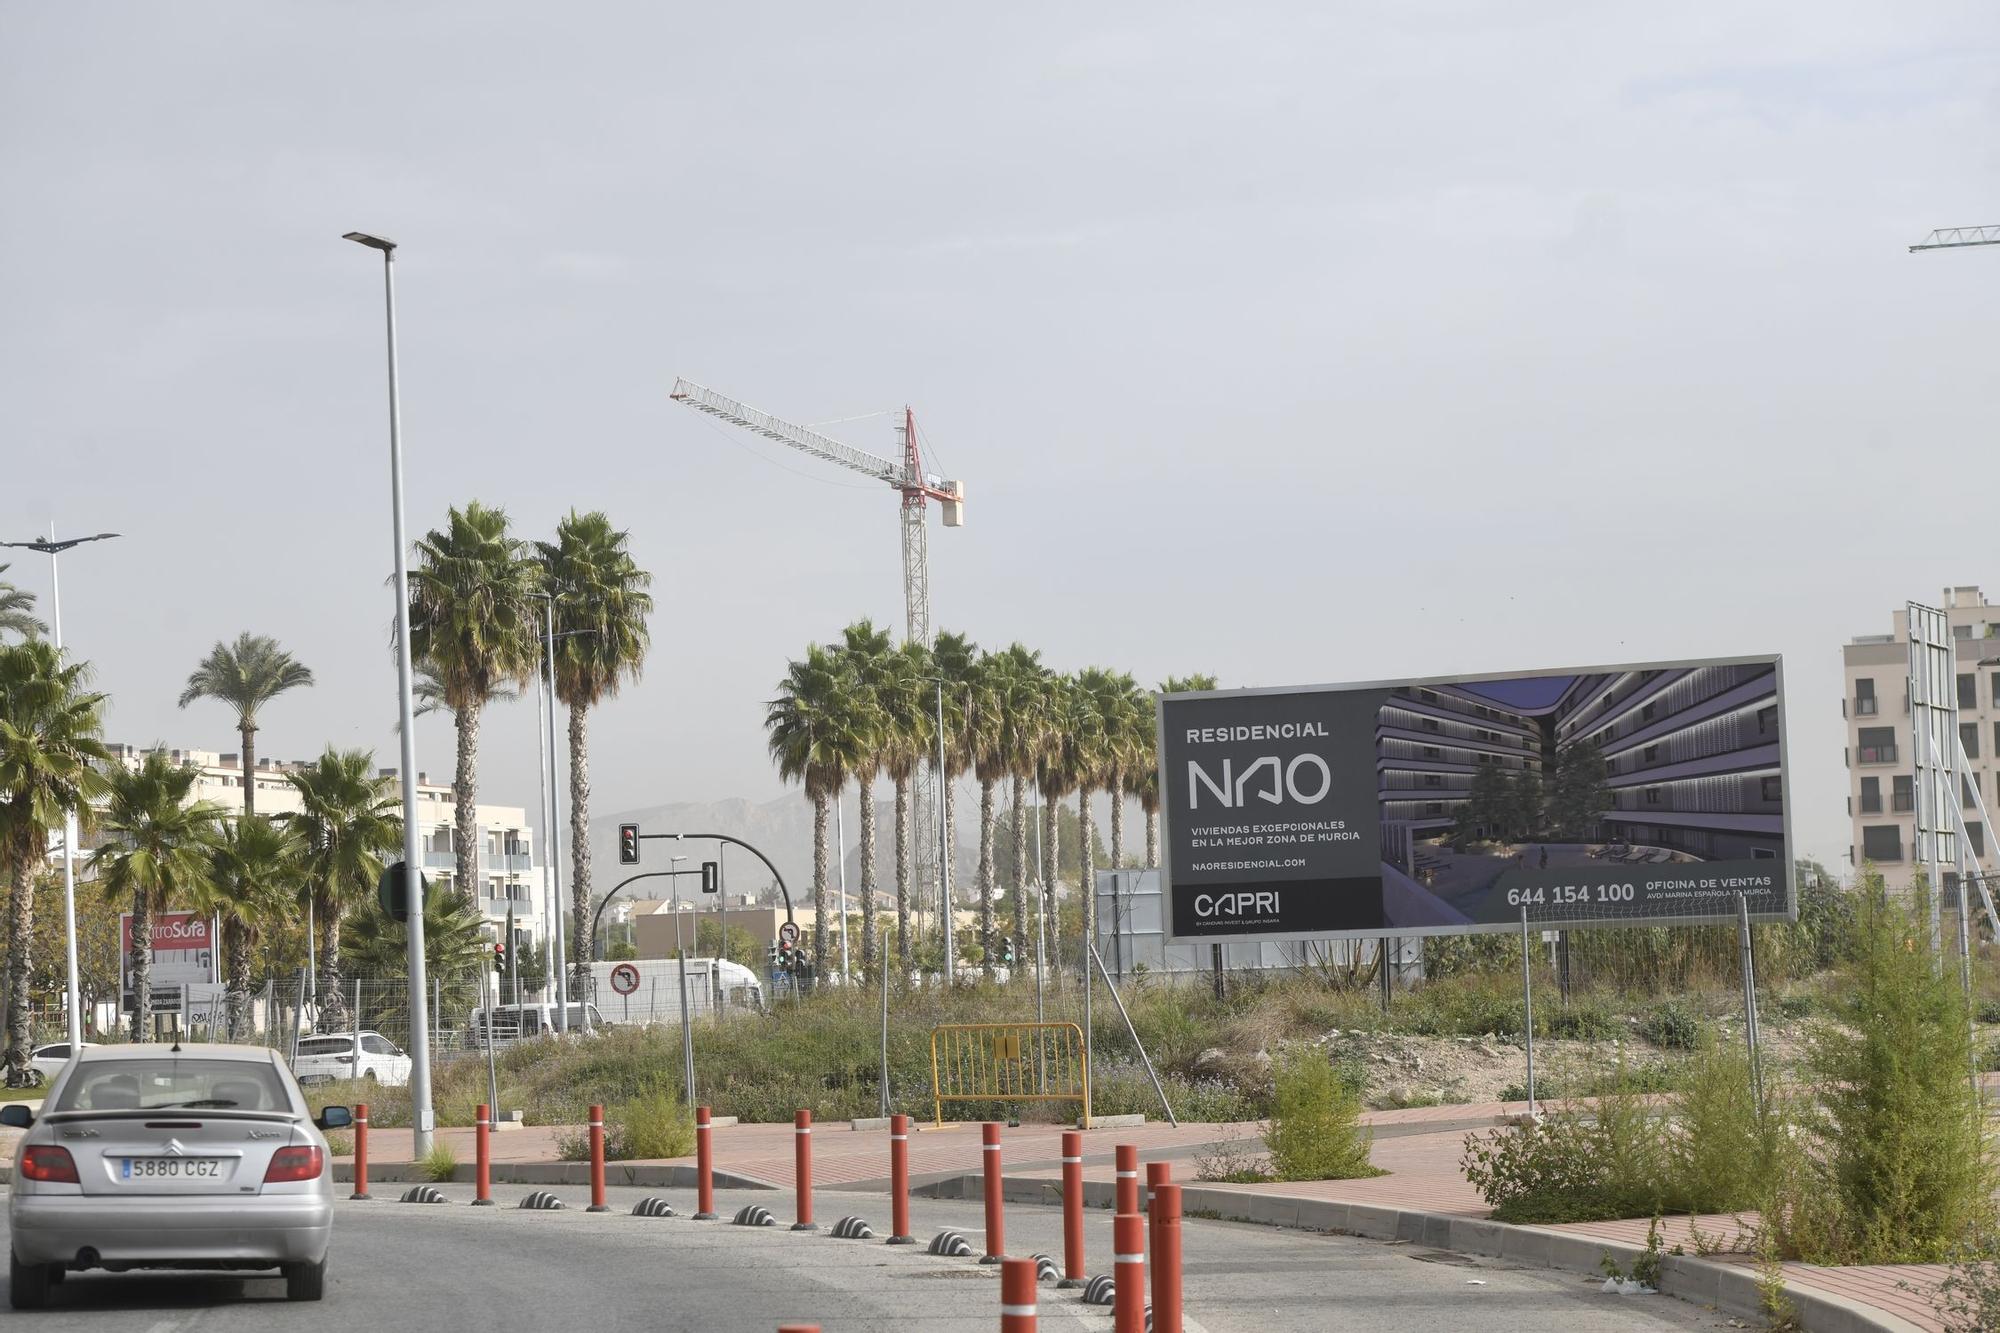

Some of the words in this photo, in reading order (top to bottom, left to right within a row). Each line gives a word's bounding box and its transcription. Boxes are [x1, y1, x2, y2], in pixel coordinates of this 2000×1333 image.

[1186, 722, 1329, 744] RESIDENCIAL
[1187, 753, 1331, 810] NAO
[1191, 825, 1250, 836] VIVIENDAS
[1252, 821, 1346, 834] EXCEPCIONALES
[1192, 839, 1207, 848] EN
[1210, 837, 1224, 847] LA
[1226, 836, 1264, 847] MEJOR
[1266, 834, 1297, 845] ZONA
[1300, 833, 1315, 843] DE
[1318, 831, 1361, 842] MURCIA
[1192, 858, 1307, 872] NAORESIDENCIAL.COM
[1646, 880, 1696, 890] OFICINA
[1700, 879, 1717, 888] DE
[1720, 877, 1772, 887] VENTAS
[1507, 887, 1546, 905] 644
[1552, 885, 1590, 904] 154
[1597, 883, 1635, 901] 100
[1664, 891, 1693, 899] MARINA
[1694, 889, 1731, 898] ESPAÑOLA
[1743, 888, 1772, 896] MURCIA
[1194, 891, 1280, 917] CAPRI
[134, 1161, 179, 1177] 5880
[185, 1161, 218, 1177] CGZ
